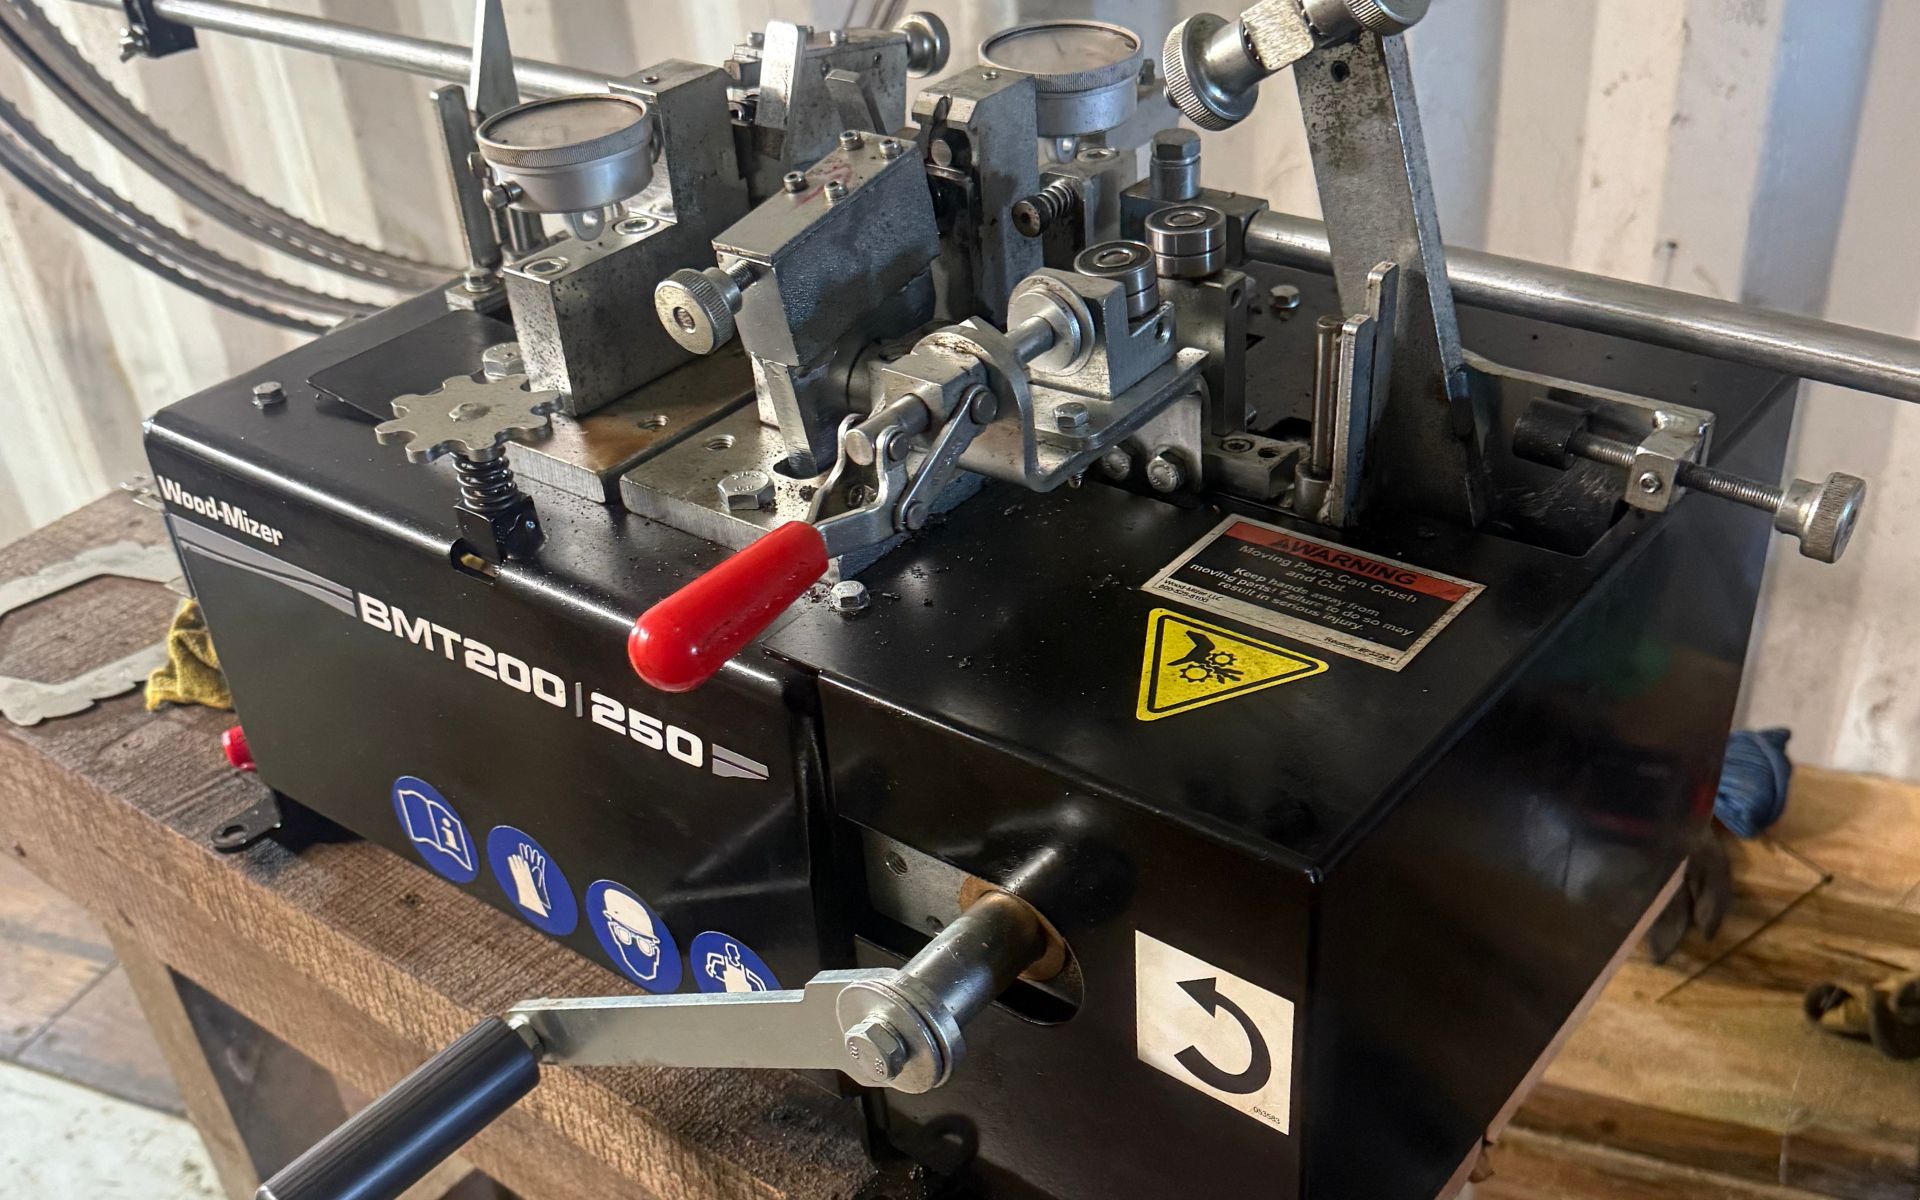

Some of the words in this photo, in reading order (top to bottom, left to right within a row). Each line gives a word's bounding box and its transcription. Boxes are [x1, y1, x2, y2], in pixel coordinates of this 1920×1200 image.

[156, 474, 283, 546] Wood-Mizer
[1164, 579, 1208, 596] Wood-Mizer
[1238, 545, 1292, 567] Moving
[1294, 561, 1334, 578] Parts
[1337, 574, 1367, 588] Can
[1370, 584, 1417, 603] Crush
[1285, 570, 1317, 583] and
[1291, 540, 1417, 585] WARNING
[1190, 564, 1237, 583] moving
[1236, 579, 1277, 594] parts!
[1279, 589, 1323, 607] Failure
[1325, 605, 1340, 613] to
[1341, 610, 1360, 620] do
[1362, 617, 1381, 626] so
[1382, 623, 1415, 636] may
[1217, 581, 1256, 597] result
[1256, 593, 1270, 601] in
[1271, 598, 1320, 617] serious
[1322, 612, 1364, 631] injury.
[1233, 567, 1266, 582] Keep
[1268, 578, 1309, 594] hands
[1310, 593, 1347, 606] away
[1346, 602, 1380, 617] from
[357, 591, 567, 708] BMT200
[590, 691, 703, 768] 250
